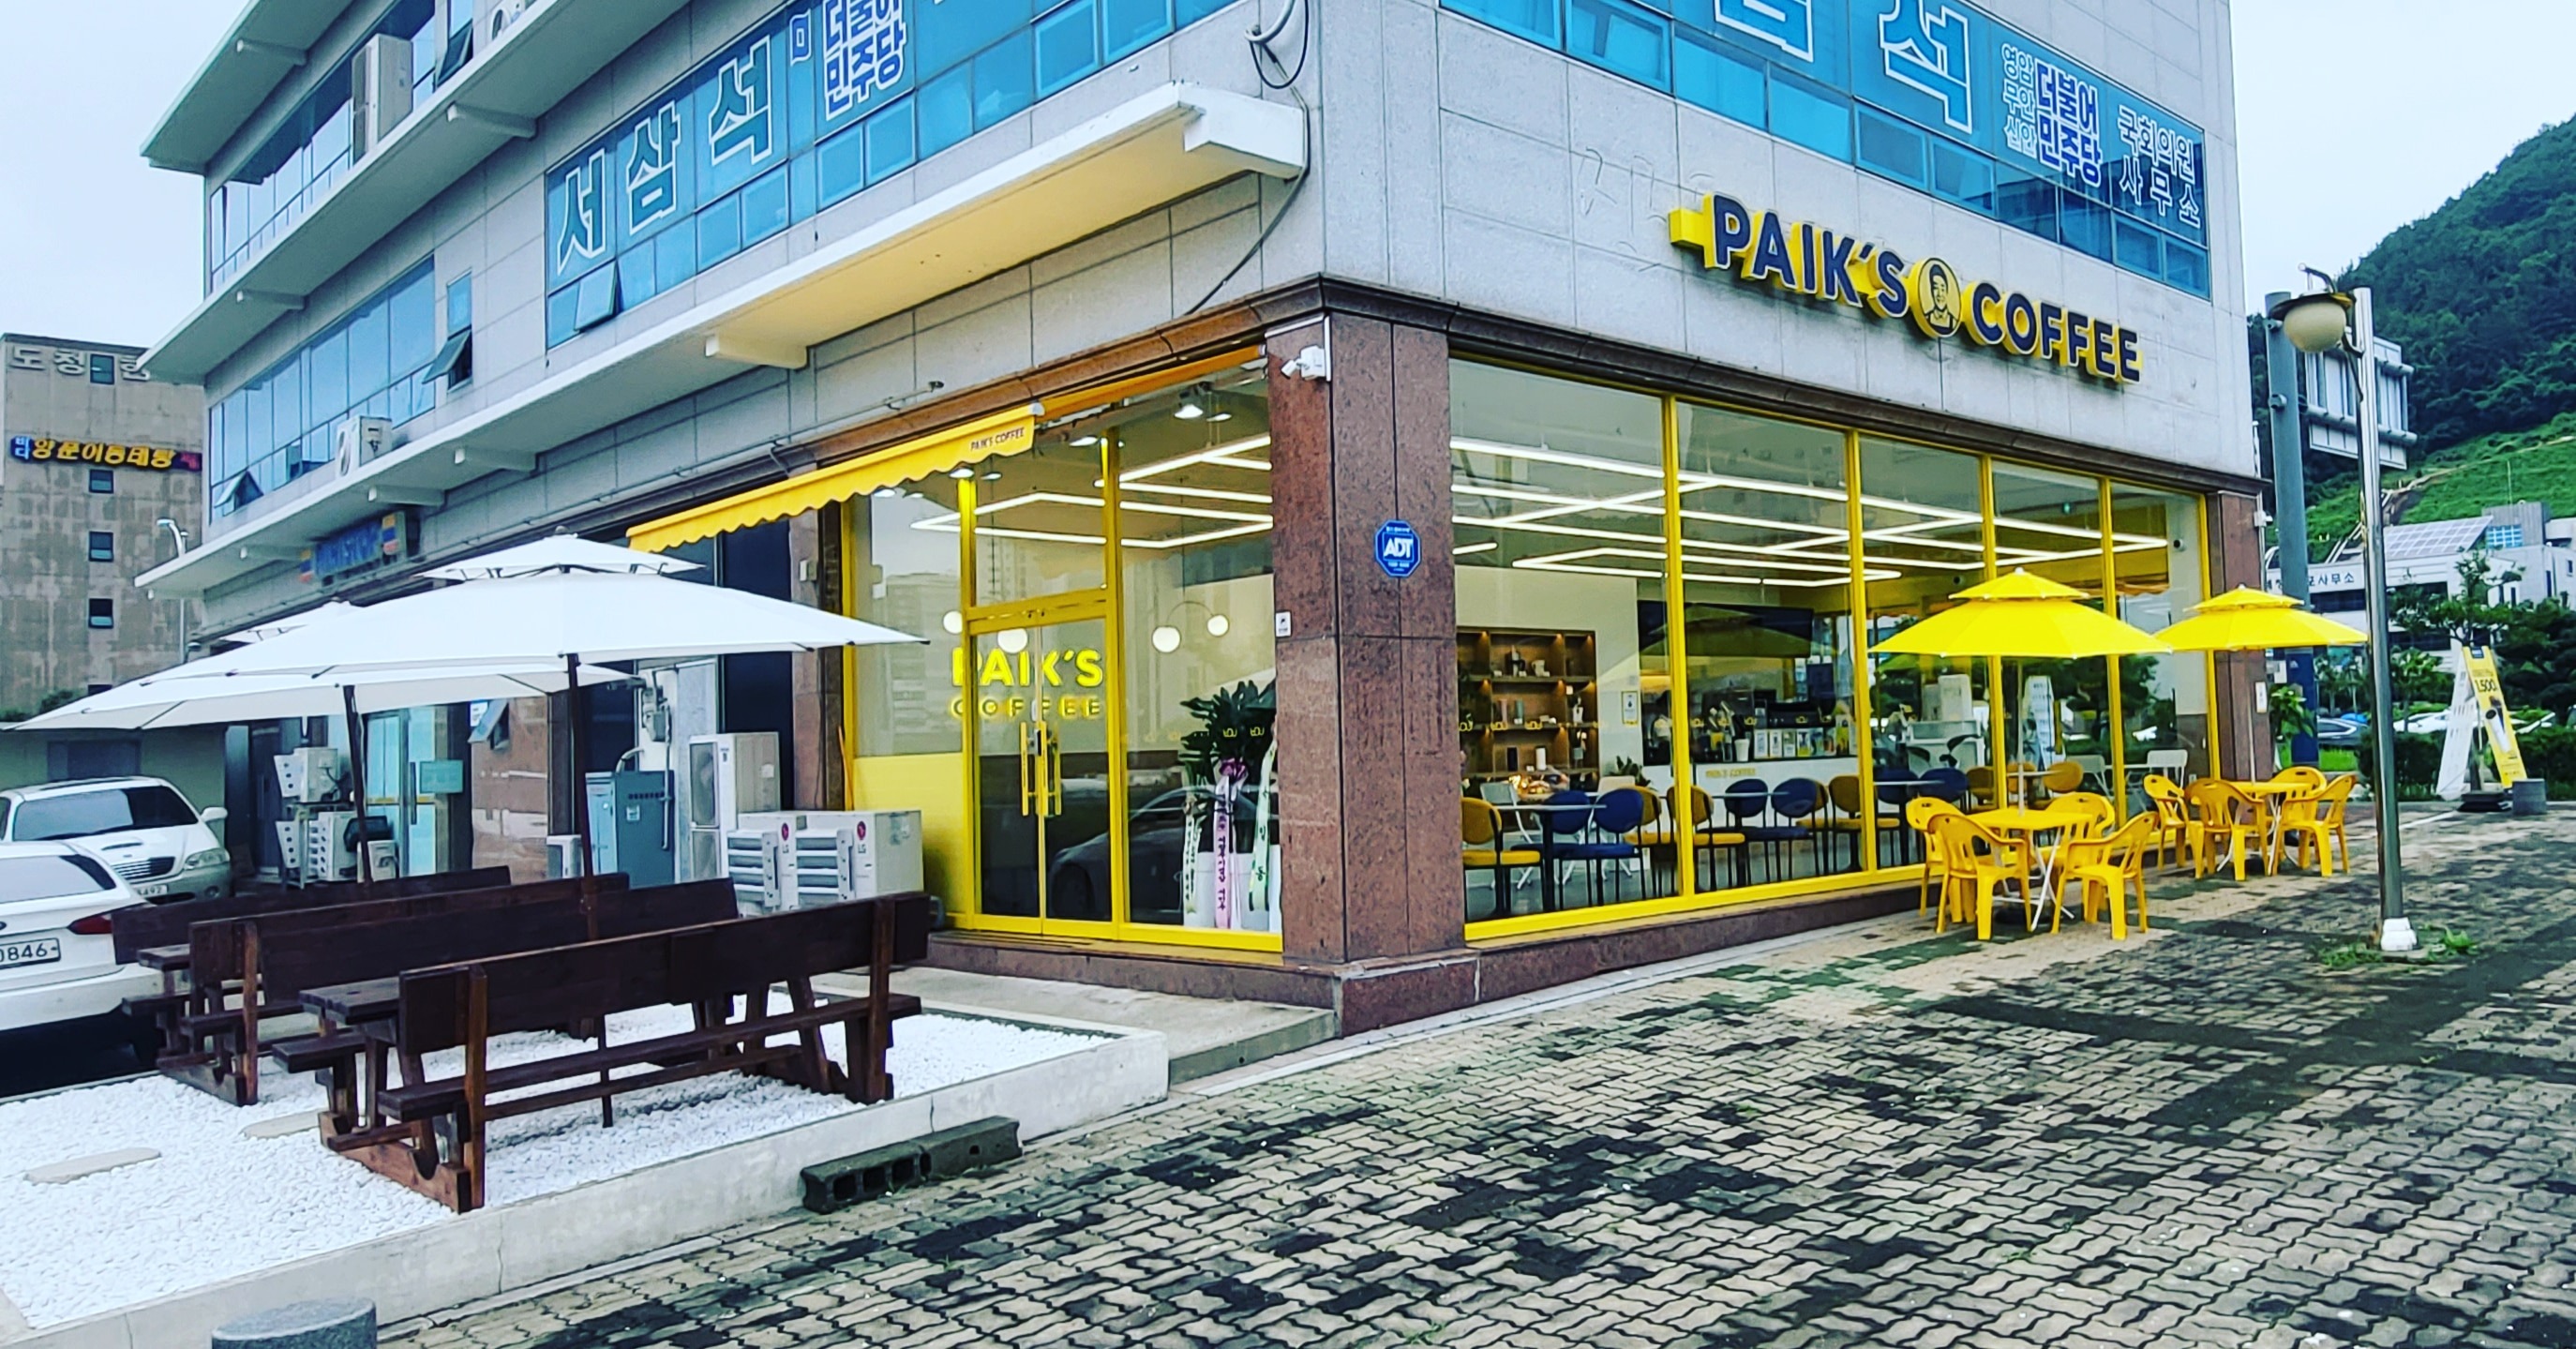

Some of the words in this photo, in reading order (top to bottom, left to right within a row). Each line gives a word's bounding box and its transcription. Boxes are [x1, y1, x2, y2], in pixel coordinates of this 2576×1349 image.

[825, 21, 907, 120] 민주당
[2001, 43, 2034, 88] 영암
[2002, 79, 2036, 124] 무안
[2034, 58, 2098, 135] 더불어
[557, 35, 772, 275] 서삼석
[2038, 110, 2103, 188] 민주당
[2118, 104, 2195, 185] 국회의원
[2119, 155, 2201, 229] 사무소
[1713, 192, 1910, 319] PAIK'S
[1970, 281, 2141, 382] COFFEE
[1383, 537, 1414, 558] ADT
[857, 843, 867, 854] LG
